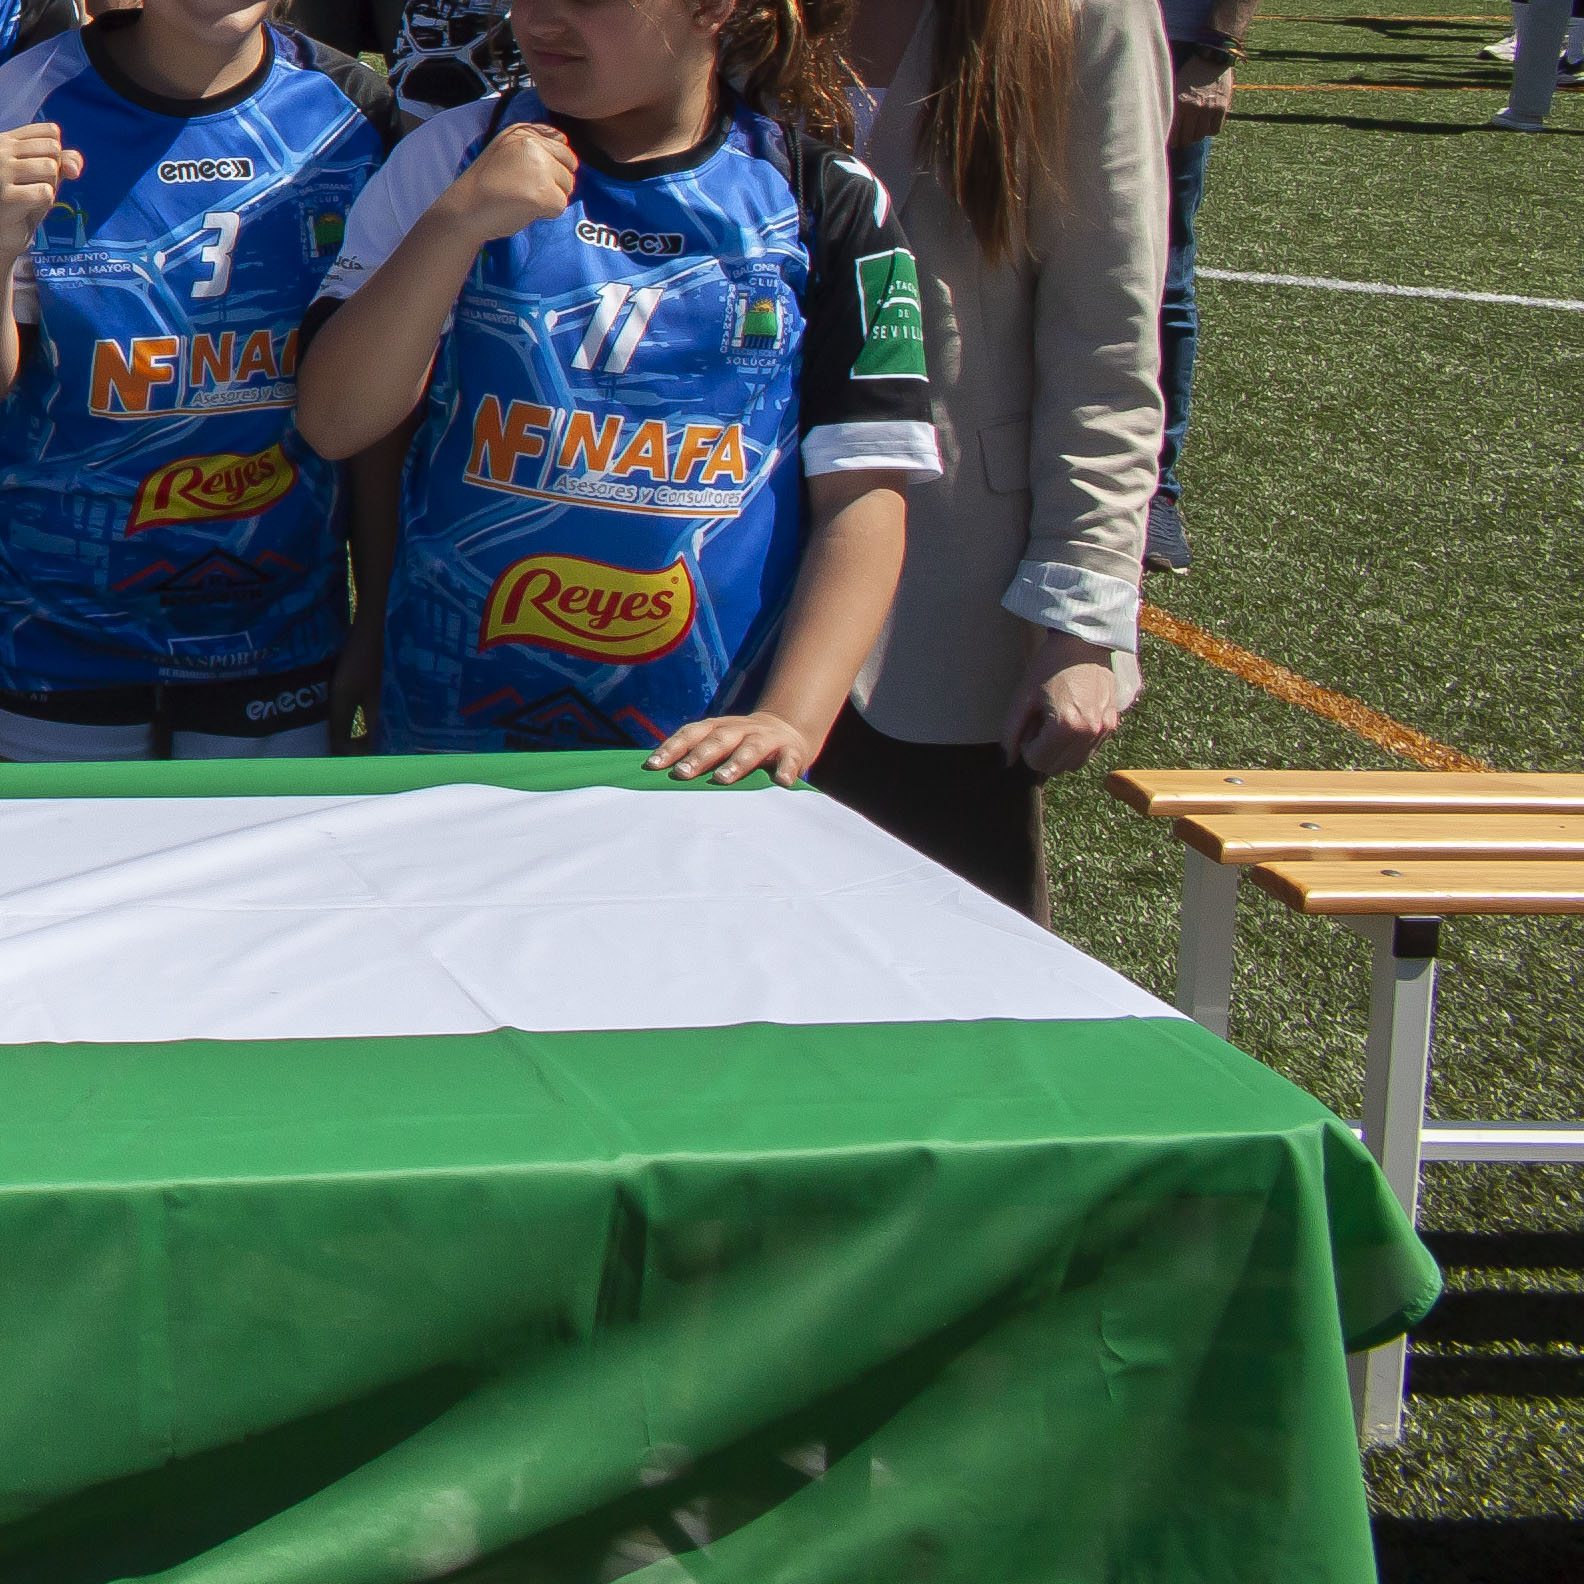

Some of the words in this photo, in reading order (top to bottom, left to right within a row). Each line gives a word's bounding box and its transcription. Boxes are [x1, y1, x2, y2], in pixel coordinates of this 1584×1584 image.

[160, 160, 232, 183] emec
[190, 211, 241, 299] 3
[577, 222, 660, 254] emec
[68, 266, 86, 276] LA
[88, 263, 132, 275] MAYOR
[570, 281, 665, 375] 11
[897, 308, 910, 318] DE
[89, 336, 179, 412] NF
[192, 388, 259, 406] Asesores
[466, 395, 553, 483] NF
[558, 411, 745, 482] NAFA
[153, 451, 276, 511] Reyes
[555, 476, 634, 500] Asesores
[640, 486, 652, 504] y
[656, 487, 741, 505] Consultores
[500, 568, 674, 640] Reyes
